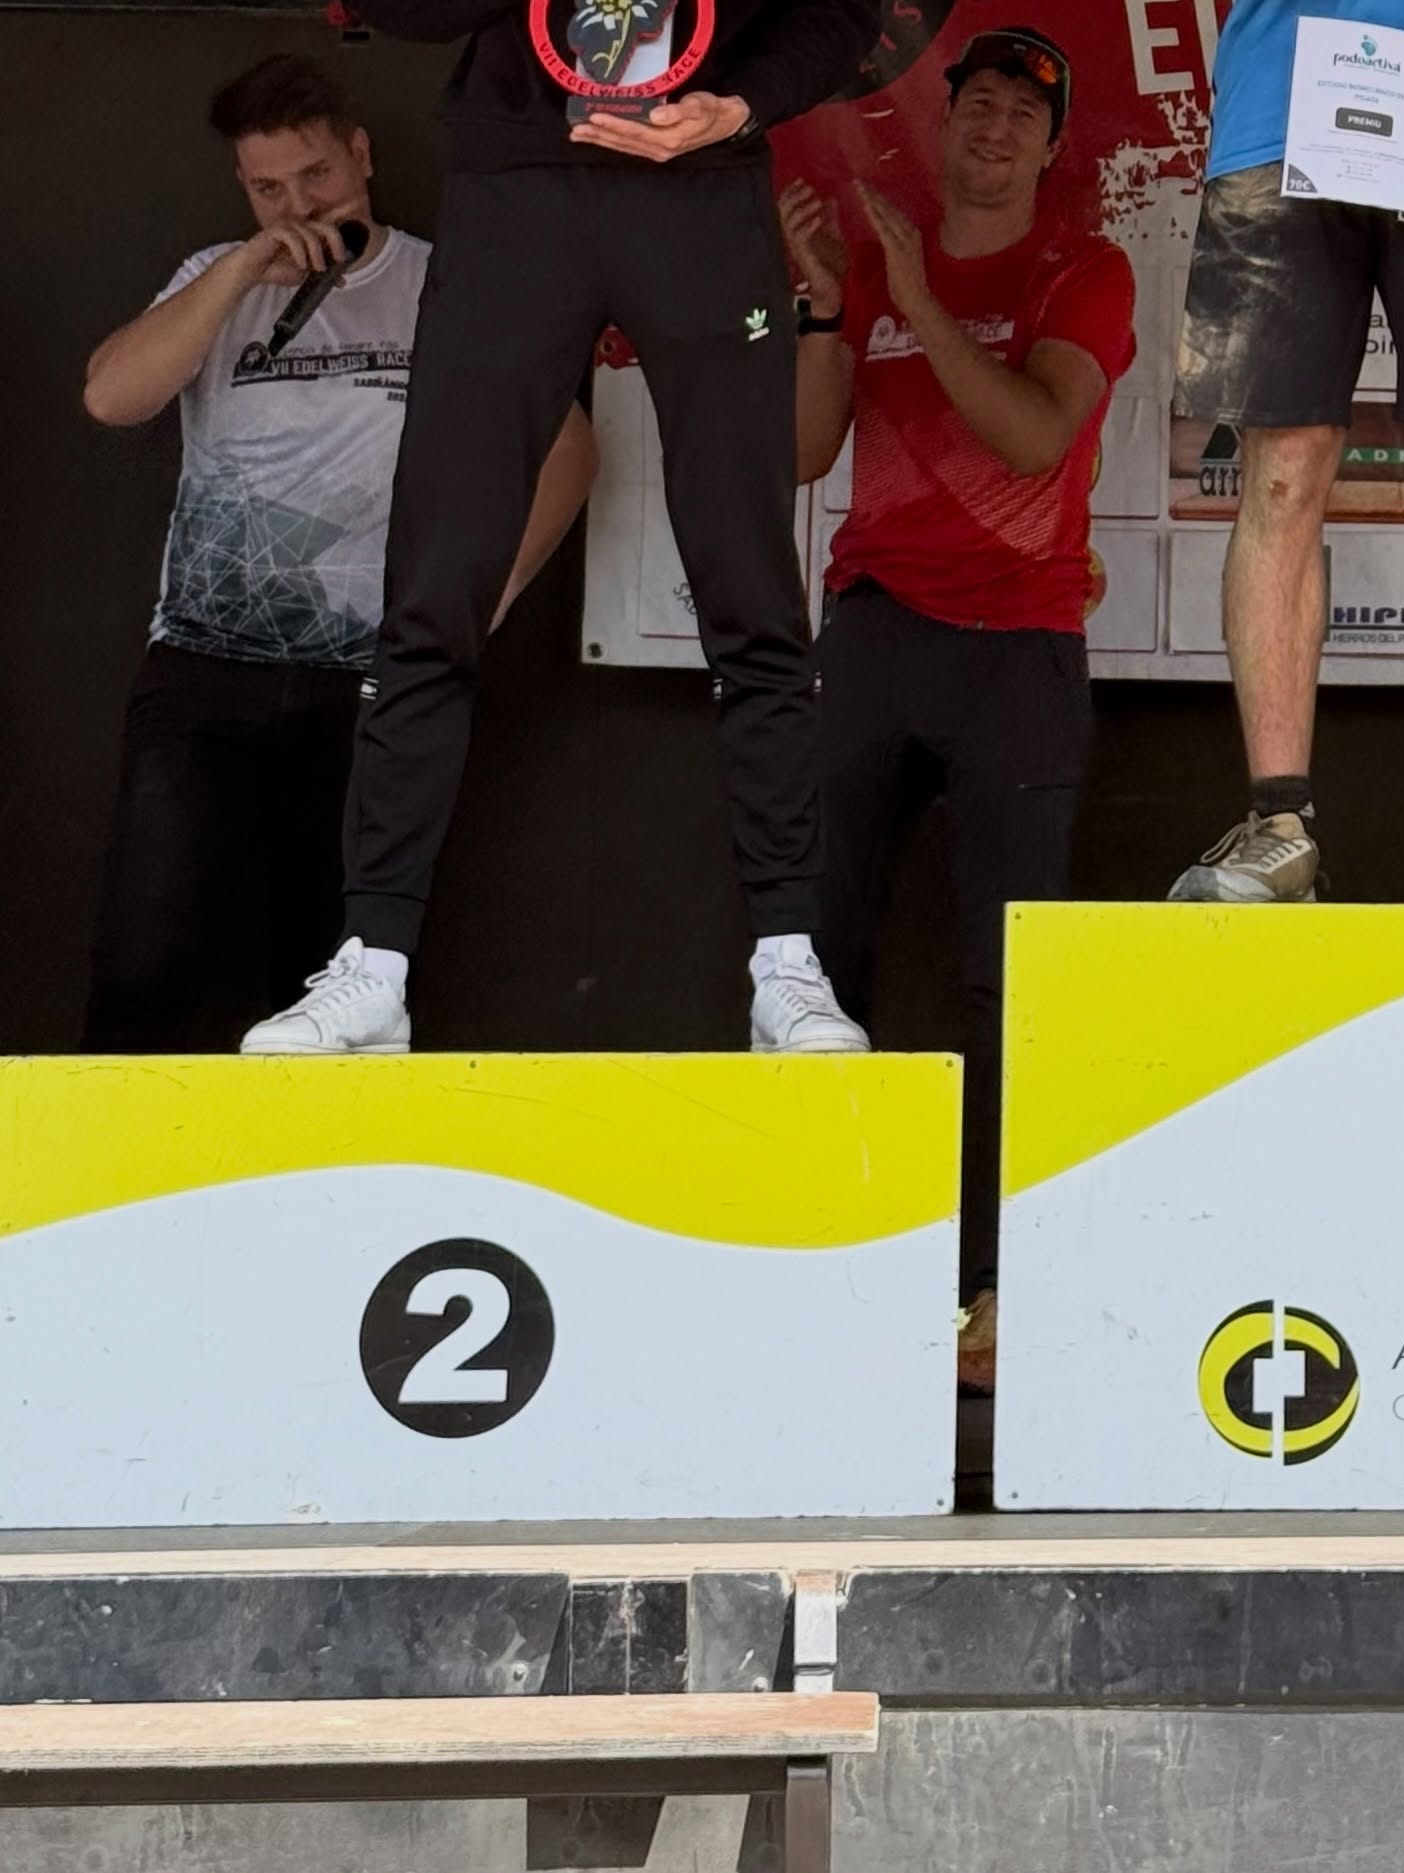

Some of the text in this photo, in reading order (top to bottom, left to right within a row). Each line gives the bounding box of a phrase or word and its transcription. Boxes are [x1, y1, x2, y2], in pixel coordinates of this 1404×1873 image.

[271, 359, 290, 376] VII
[292, 354, 370, 375] EDELWEISS
[397, 1267, 512, 1404] 2
